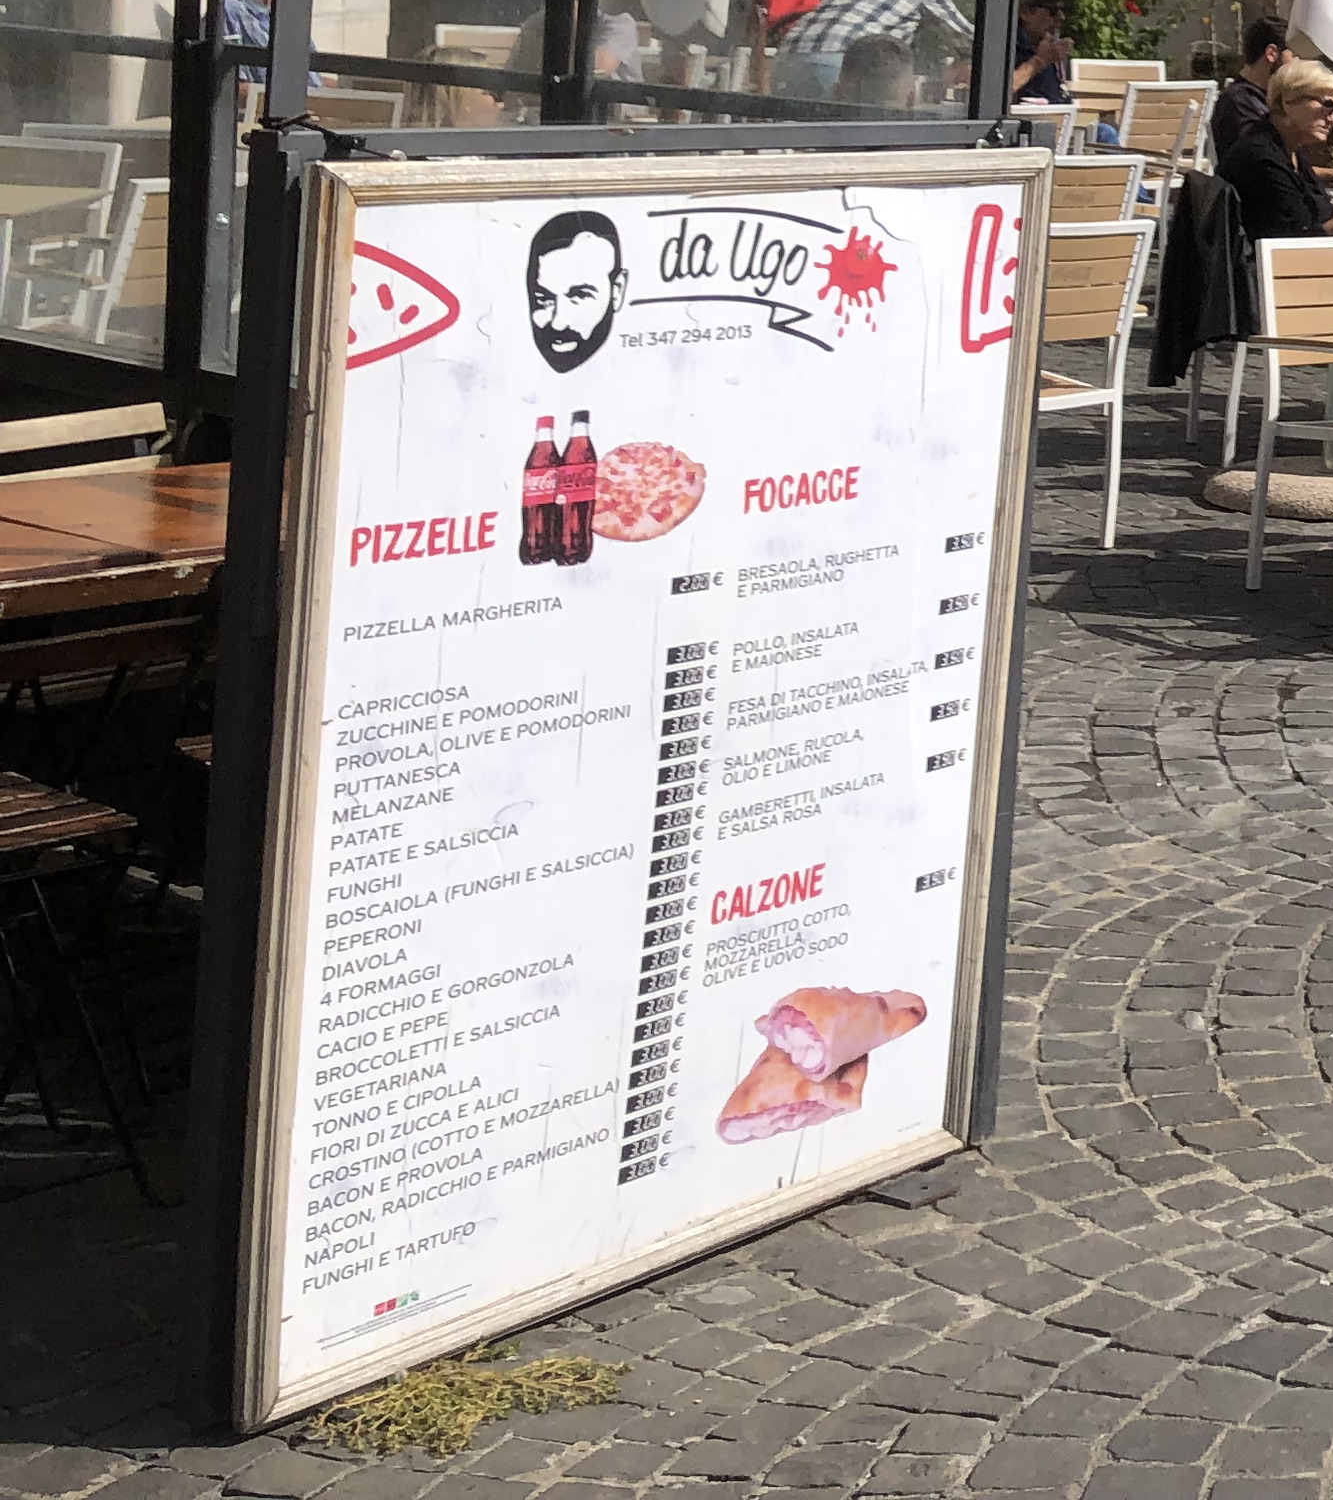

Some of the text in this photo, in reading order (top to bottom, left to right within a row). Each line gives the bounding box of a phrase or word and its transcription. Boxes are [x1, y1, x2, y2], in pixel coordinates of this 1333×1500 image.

[659, 216, 813, 299] da Ugo
[618, 324, 752, 347] Tel 347 294 2013
[743, 465, 860, 514] FOCACCE
[349, 511, 498, 567] PIZZELLE
[737, 544, 898, 581] BRESAOLA, RUGHETTA
[750, 568, 843, 595] PARMIGIANO
[343, 596, 562, 642] PIZZELLA MARGHERITA
[732, 621, 859, 656] POLLO, INSALATA
[745, 643, 822, 670] MAIONESE
[336, 690, 577, 746] ZUCCHINE E POMODORINI
[337, 685, 469, 719] CAPRICCIOSA
[726, 699, 822, 730] PARMIGIANO
[837, 680, 909, 706] MAIONESE
[727, 695, 766, 714] FESA
[770, 691, 785, 706] DI
[789, 676, 863, 701] TACCHINO,
[335, 704, 630, 772] PROVOLA, OLIVE E POMODORINI
[723, 728, 863, 771] SALMONE, RUCOLA,
[333, 761, 460, 799] PUTTANESCA
[721, 766, 758, 786] OLIO
[775, 749, 831, 774] LIMONE
[332, 786, 453, 824] MELANZANE
[718, 772, 884, 824] GAMBERETTI, INSALATA
[730, 814, 778, 836] SALSA
[782, 803, 821, 823] ROSA
[329, 823, 518, 877] PATATE E SALSICCIA
[330, 822, 403, 850] PATATE
[325, 842, 634, 929] BOSCAIOLA (FUNGHI E SALSICCIA)
[326, 873, 401, 903] FUNGHI
[710, 862, 825, 925] CALZONE
[323, 918, 421, 955] PEPERONI
[703, 931, 805, 971] MOZZARELLA,
[705, 903, 849, 956] PROSCIUTTO COTTO,
[321, 948, 407, 981] DIAVOLA
[702, 962, 747, 987] OLIVE
[763, 945, 805, 968] UOVO
[807, 932, 848, 955] SODO
[318, 953, 573, 1033] RADICCHIO E GORGONZOLA
[319, 964, 440, 1006] 4 FORMAGGI
[315, 1004, 560, 1086] BROCCOLETTI E SALSICCIA
[316, 1011, 448, 1059] CACIO E PEPE
[311, 1075, 481, 1137] TONNO E CIPOLLA
[313, 1062, 446, 1111] VEGETARIANA
[308, 1076, 619, 1189] CROSTINO (COTTO E MOZZARELLA)
[310, 1087, 518, 1164] FIORI DI ZUCCA E ALICI
[305, 1127, 609, 1242] BACON, RADICCHIO E PARMIGIANO
[307, 1147, 482, 1216] BACON E PROVOLA
[302, 1221, 475, 1294] FUNGHI E TARTUFO
[304, 1231, 374, 1268] NAPOLI
